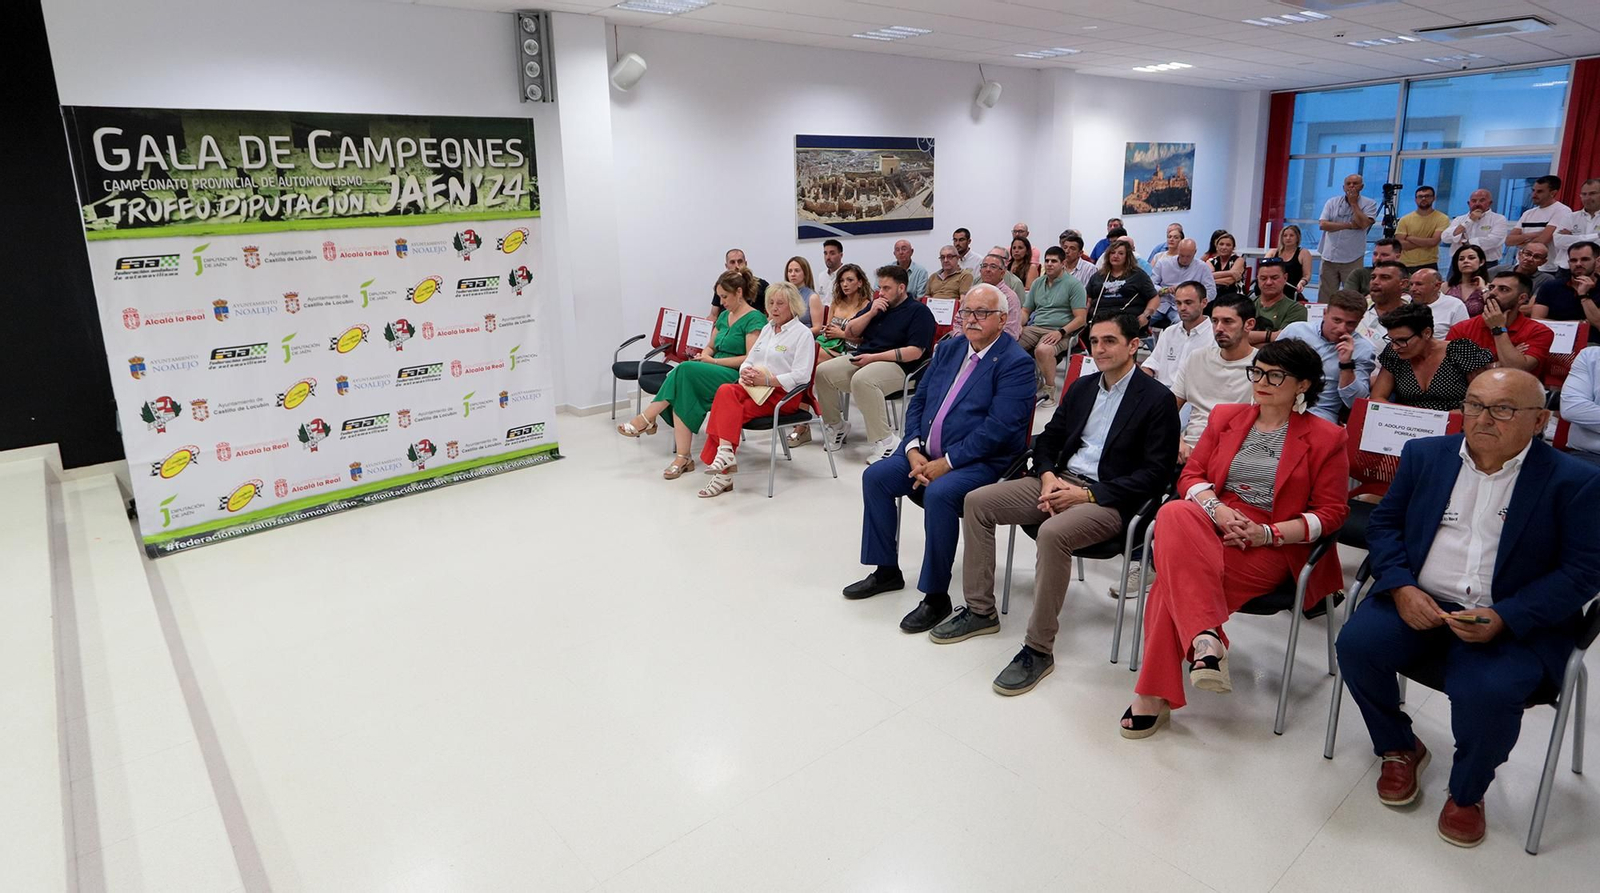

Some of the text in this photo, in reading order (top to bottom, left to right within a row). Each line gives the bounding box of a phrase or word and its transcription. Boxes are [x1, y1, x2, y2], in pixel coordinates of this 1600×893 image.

[93, 127, 524, 172] GALA DE CAMPEONES
[103, 176, 362, 191] CAMPEONATO PROVINCIAL DE AUTOMOVILISMO
[108, 195, 212, 224] TROFEO
[412, 246, 447, 255] NOALEJO
[235, 305, 278, 316] NOALEJO
[153, 361, 199, 373] NOALEJO
[354, 380, 390, 390] NOALEJO
[512, 394, 541, 402] NOALEJO
[367, 463, 402, 475] NOALEJO
